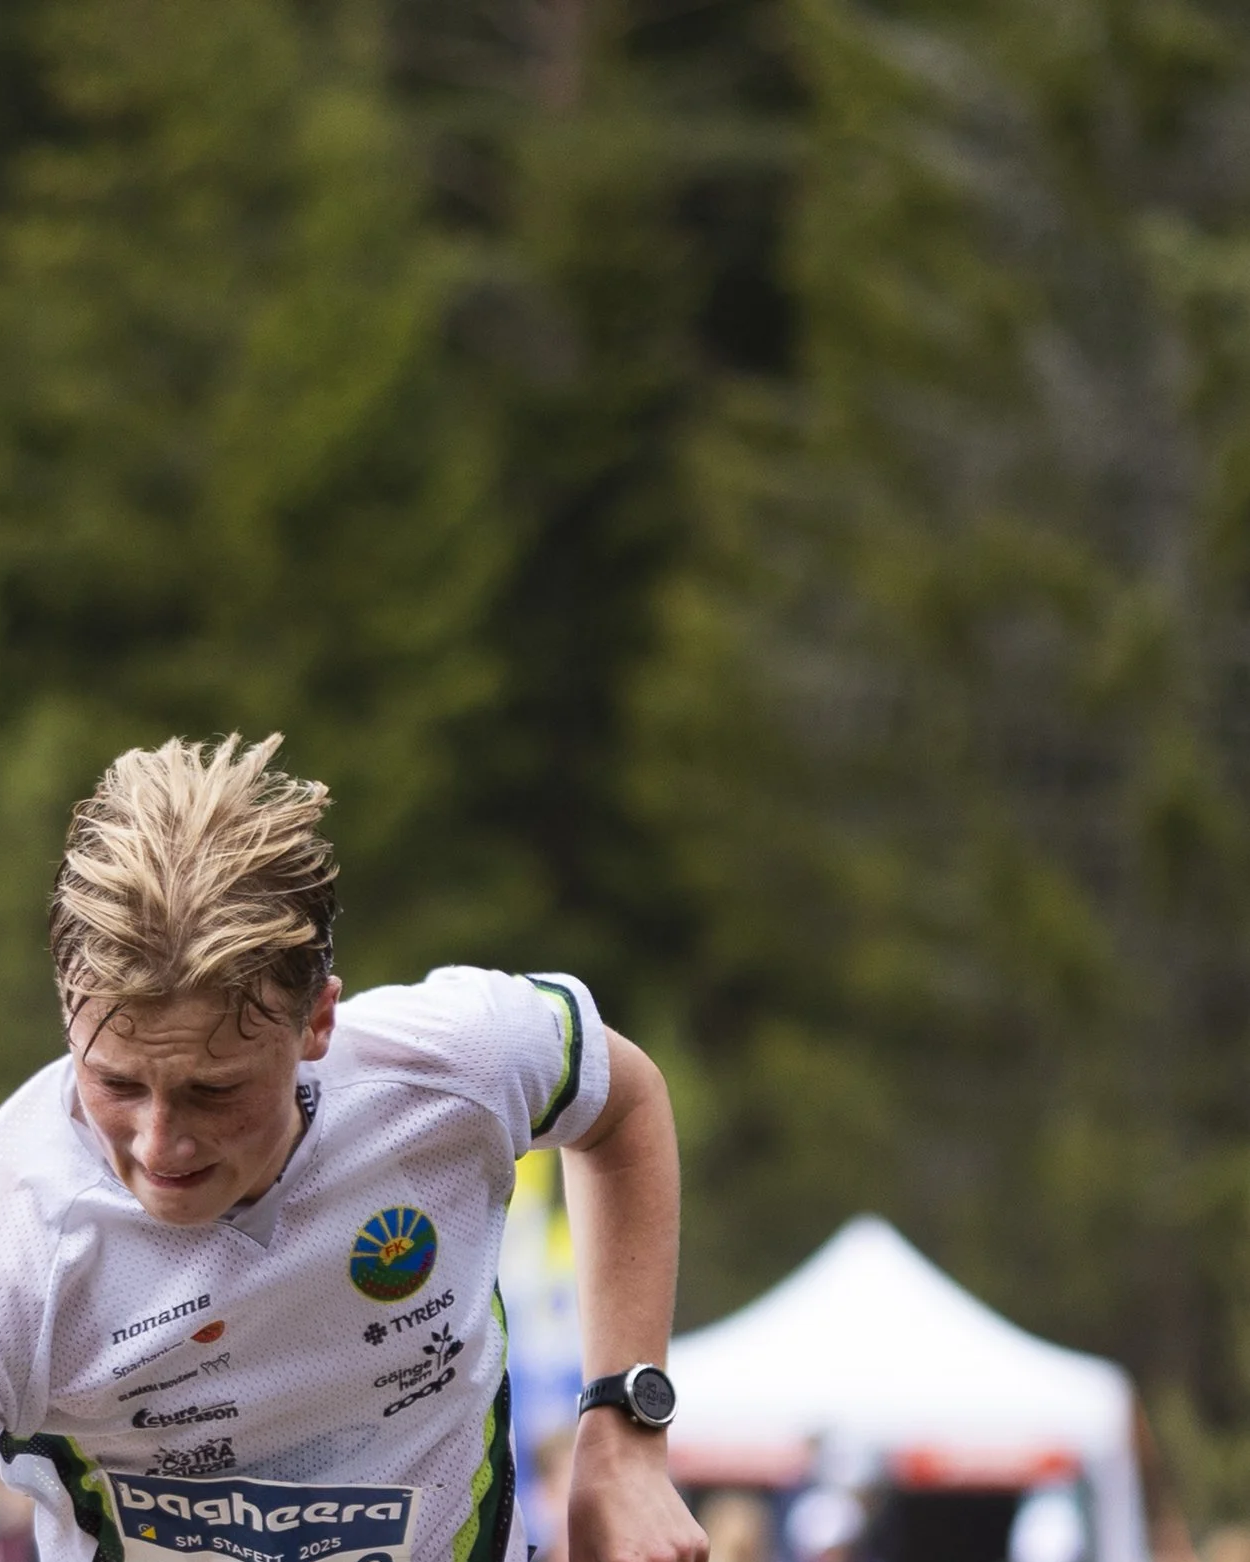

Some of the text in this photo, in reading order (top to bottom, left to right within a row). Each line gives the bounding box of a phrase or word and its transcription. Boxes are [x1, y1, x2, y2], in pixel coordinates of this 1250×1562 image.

[385, 1240, 406, 1257] FK
[112, 1293, 211, 1345] noname
[383, 1367, 456, 1417] coop
[120, 1482, 403, 1533] bagheera
[175, 1534, 203, 1548] SM
[299, 1537, 342, 1561] 2025
